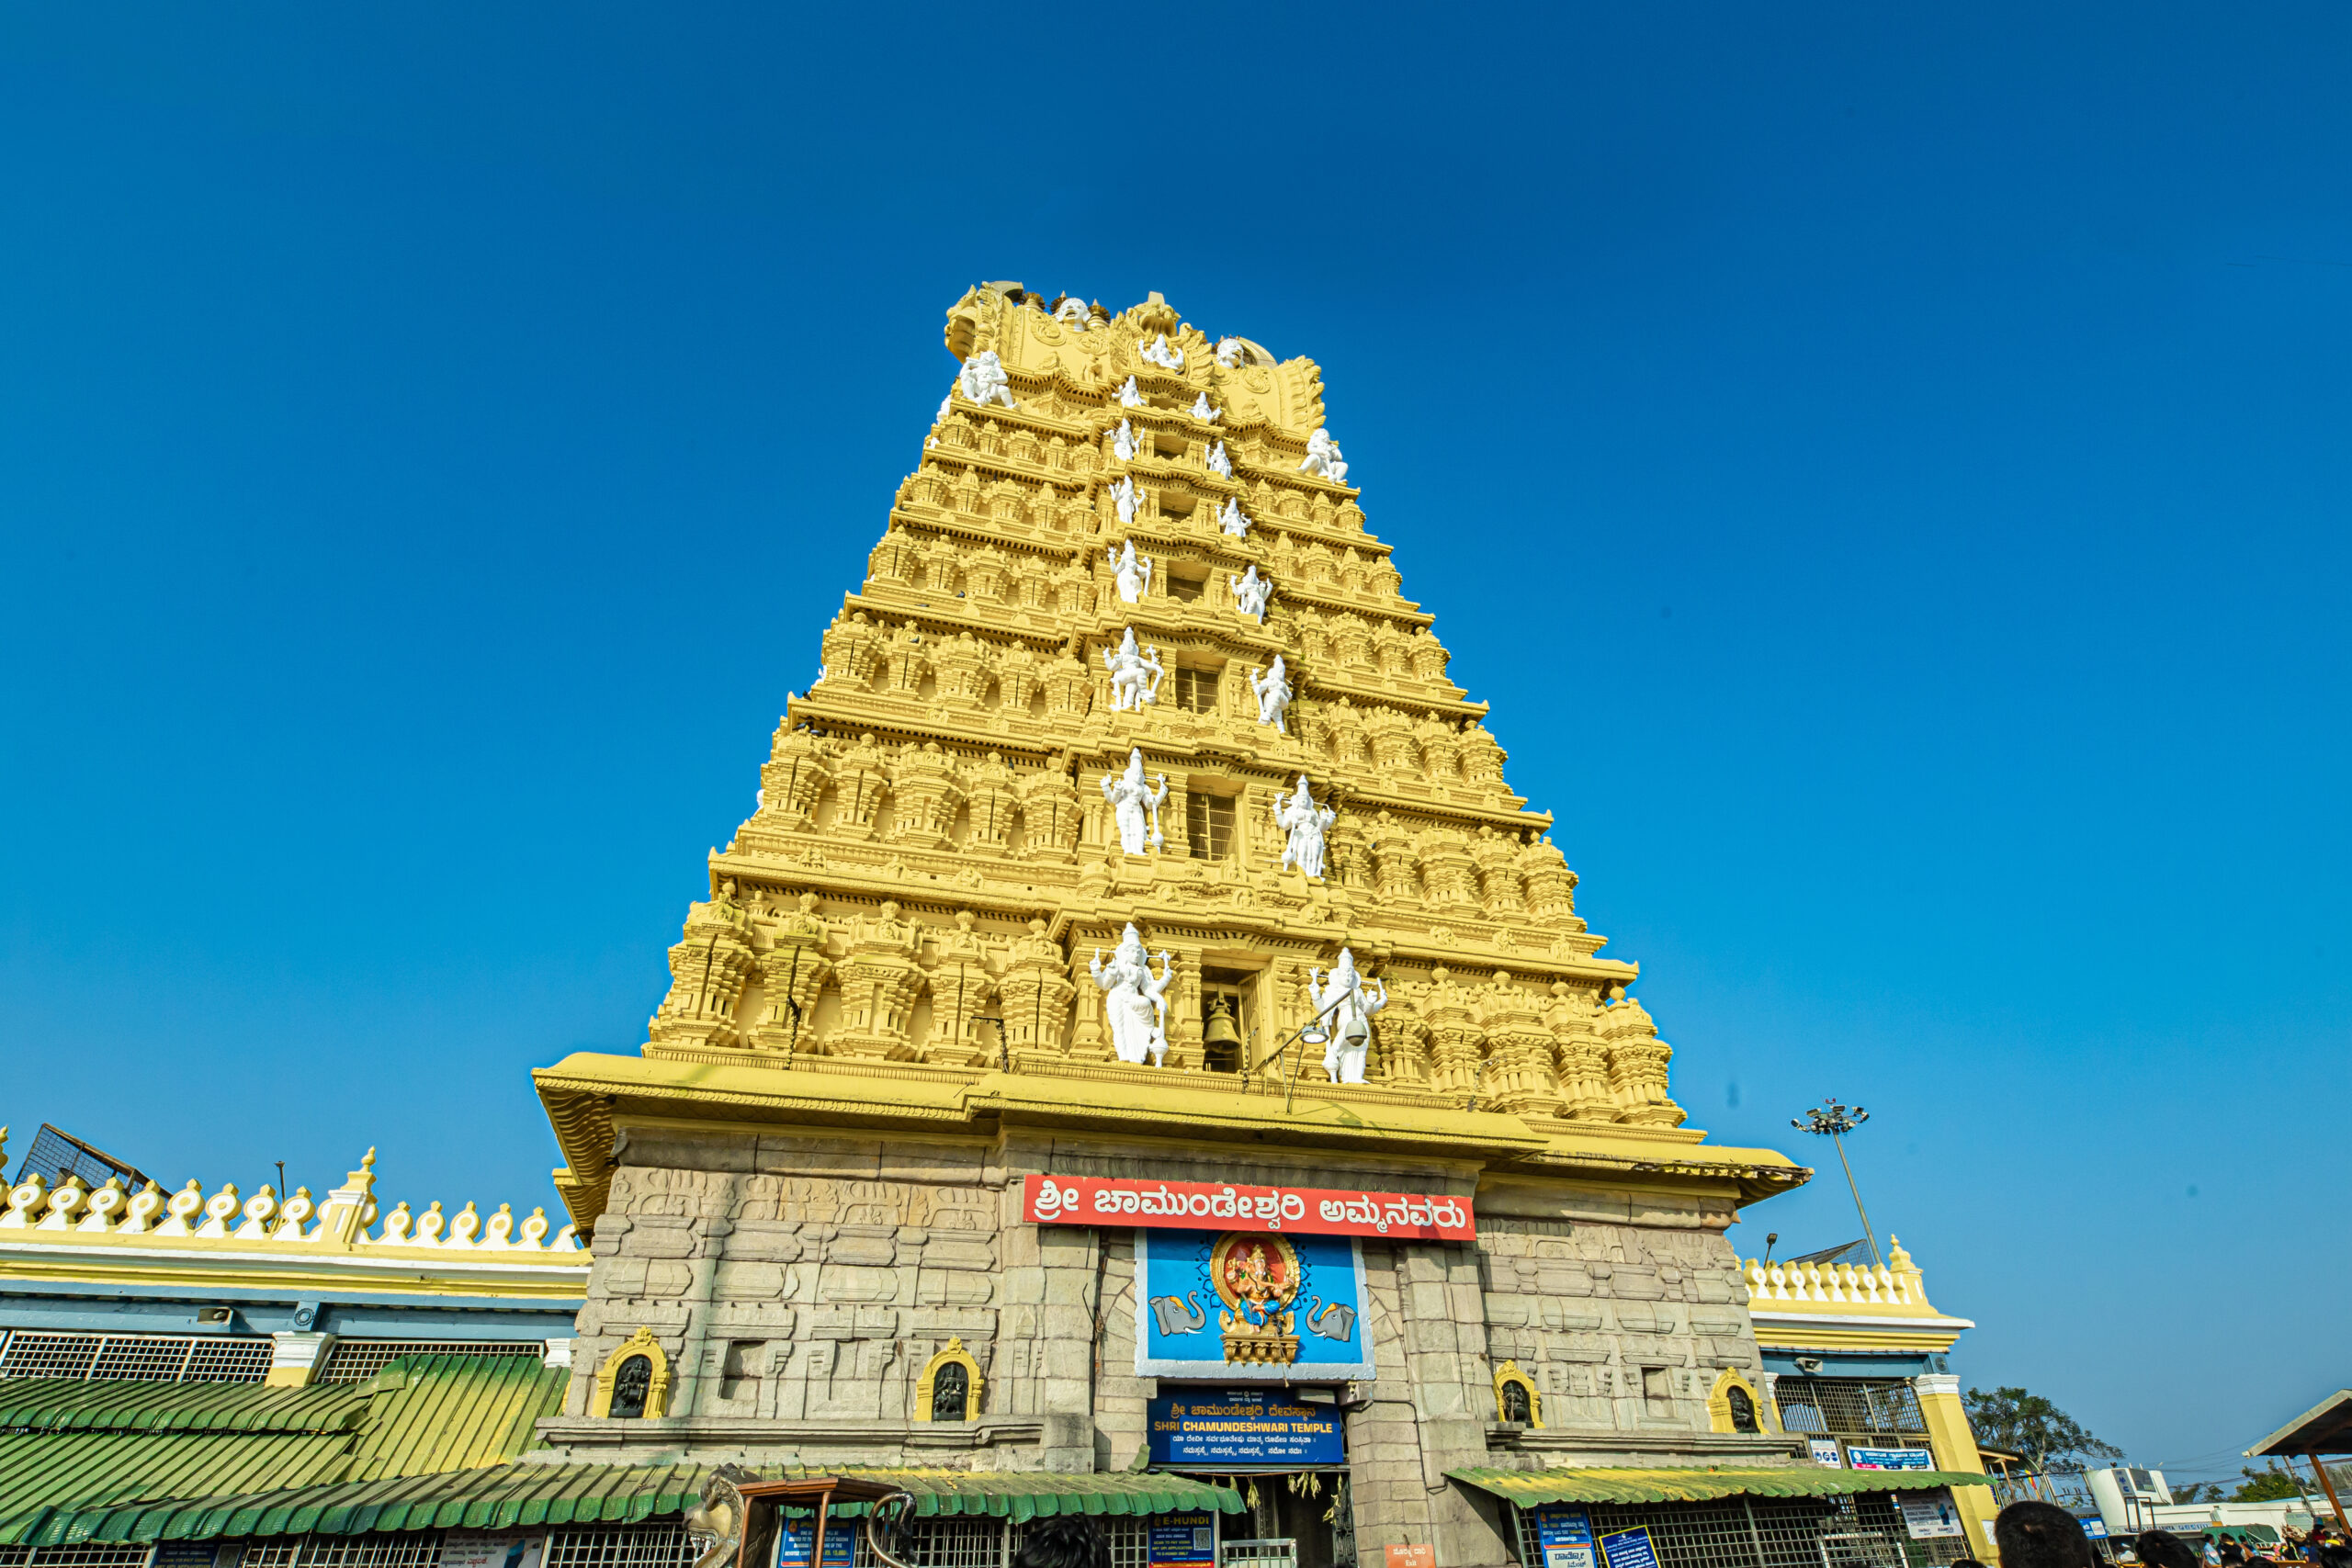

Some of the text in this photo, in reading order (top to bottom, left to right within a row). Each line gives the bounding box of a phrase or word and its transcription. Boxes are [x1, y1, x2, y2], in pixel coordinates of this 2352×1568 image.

[1034, 1179, 1466, 1234] ಶ್ರೀ ಚಾಮುಂಡೇಶ್ವರಿ ಅಮ್ಮನವರು
[1170, 1402, 1317, 1421] ಶ್ರೀ ಚಾಮುಂಡೇಶ್ವರಿ ದೇವಸ್ಥಾನ
[1154, 1421, 1333, 1433] SHRI CHAMUNDESHWARI TEMPLE
[1162, 1517, 1209, 1525] E-HUNDI
